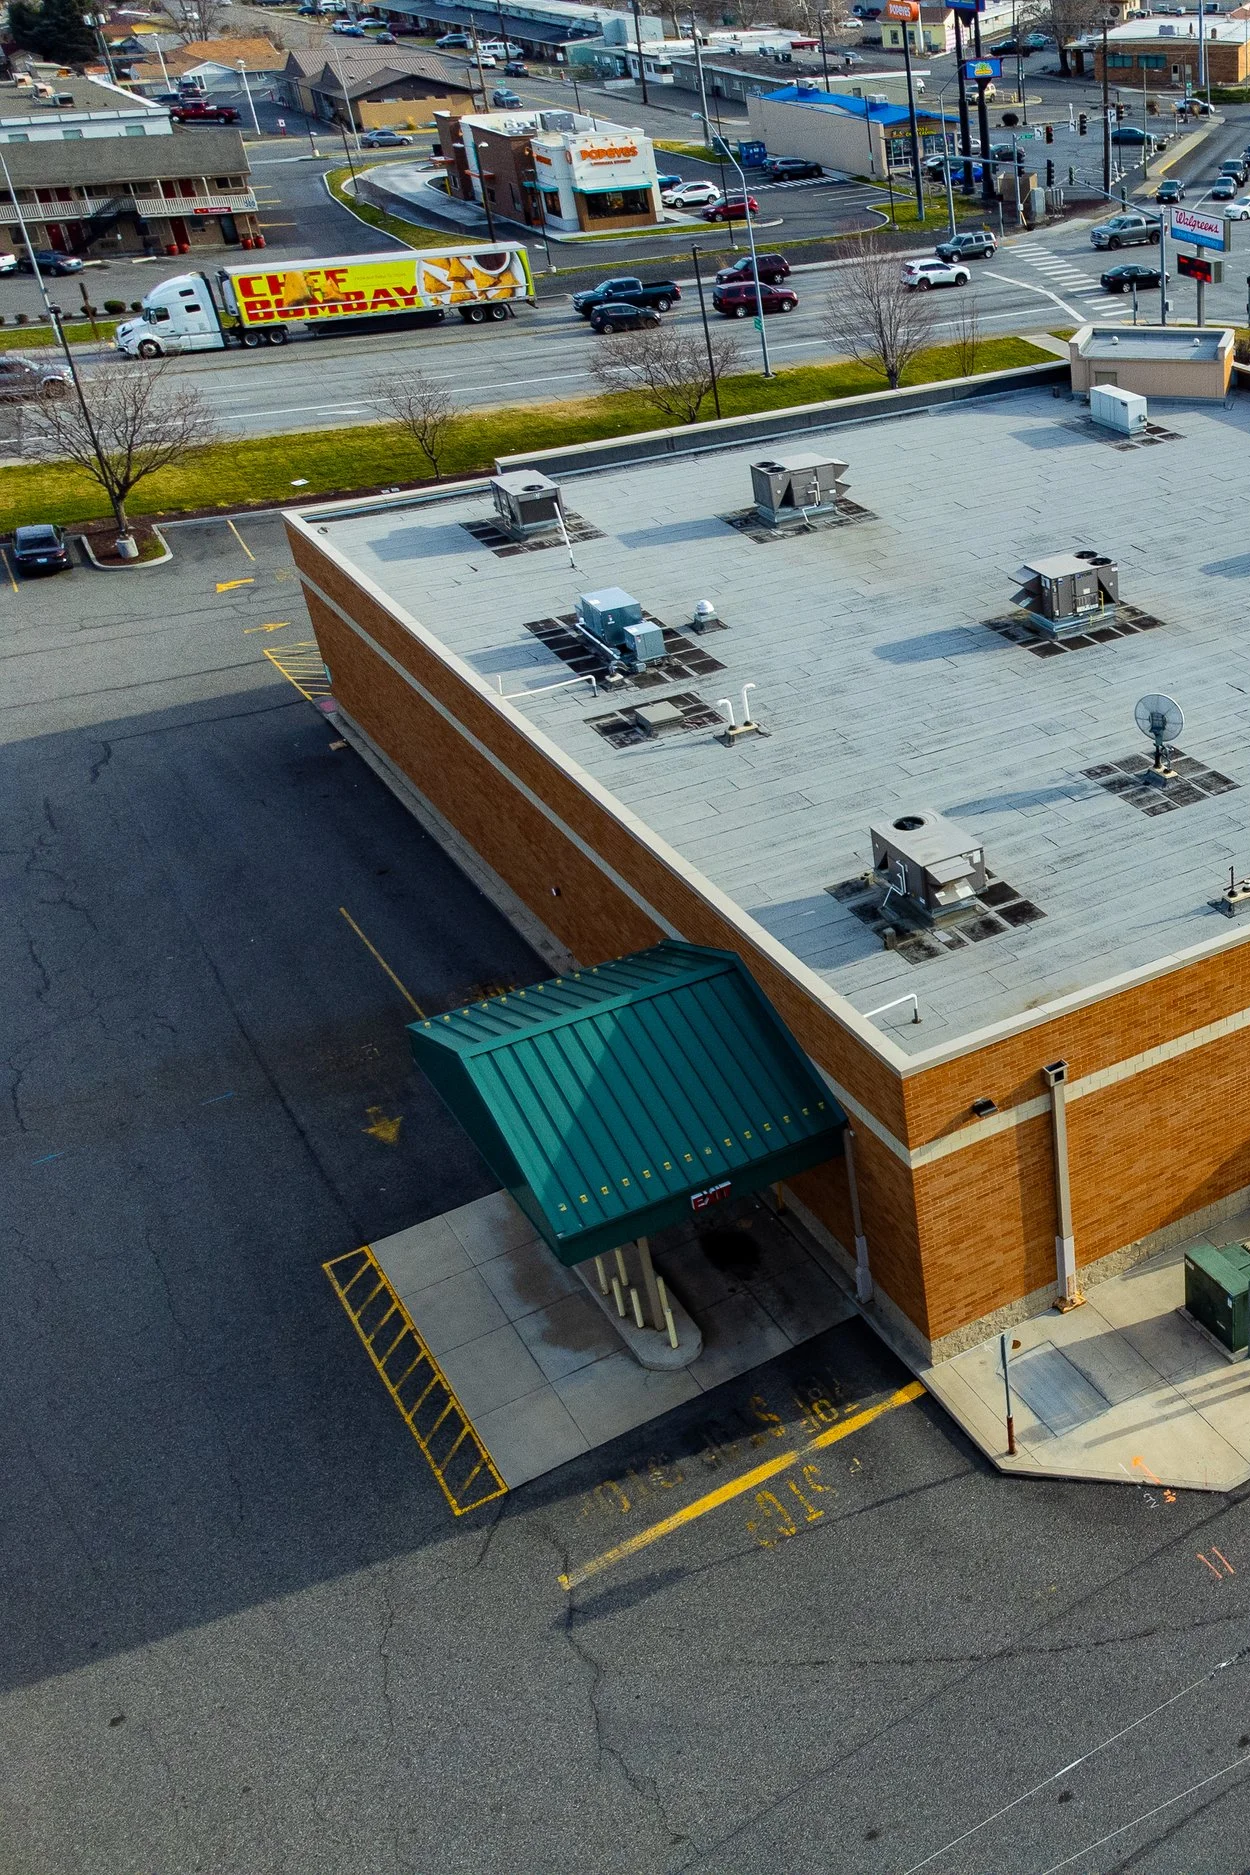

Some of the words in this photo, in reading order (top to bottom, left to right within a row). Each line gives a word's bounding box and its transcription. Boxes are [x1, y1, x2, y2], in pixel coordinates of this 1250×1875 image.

[580, 146, 638, 160] POPEYES
[1175, 210, 1220, 234] Walgreens
[238, 268, 349, 298] CHEF
[243, 285, 418, 321] BOMBAY
